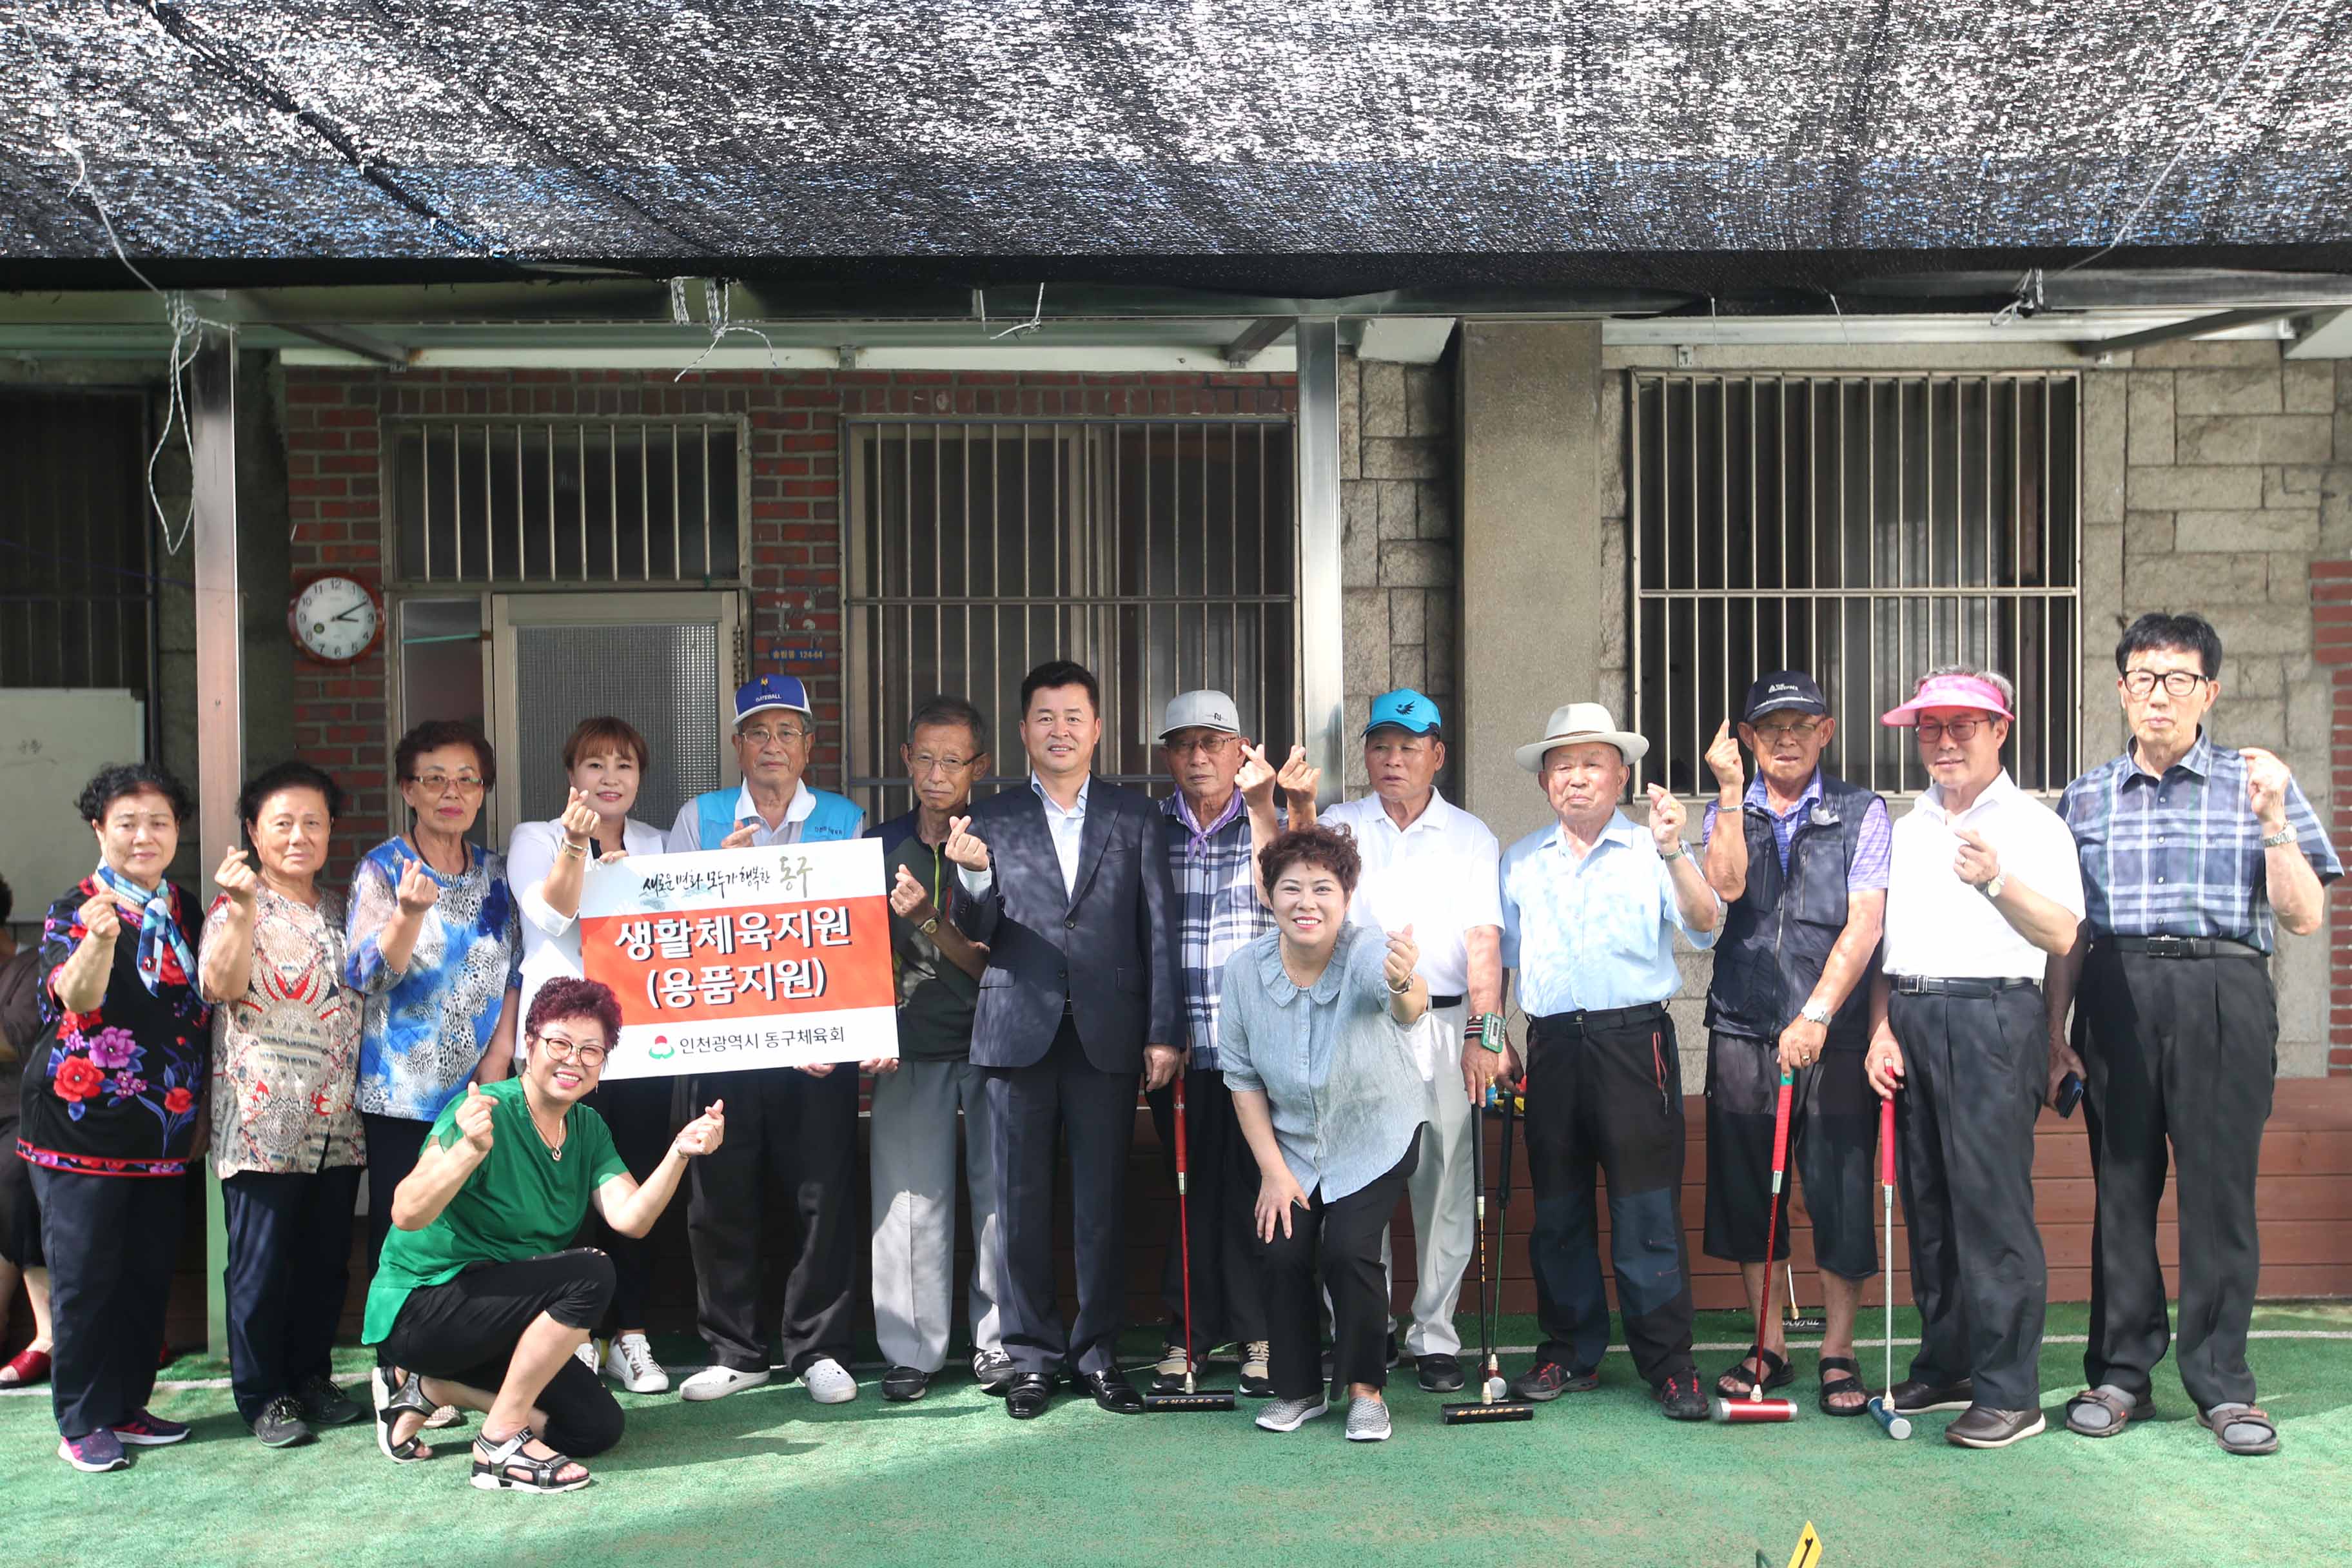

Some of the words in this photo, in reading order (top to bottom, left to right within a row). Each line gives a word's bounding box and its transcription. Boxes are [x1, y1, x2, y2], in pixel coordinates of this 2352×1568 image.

[330, 578, 342, 589] 12
[315, 585, 323, 594] 11
[352, 585, 356, 594] 1
[302, 597, 312, 607] 10
[299, 613, 307, 623] 9
[368, 613, 374, 624] 3
[306, 631, 313, 642] 8
[362, 631, 369, 640] 4
[318, 643, 325, 654] 7
[335, 646, 341, 657] 6
[351, 642, 358, 652] 5
[643, 873, 674, 897] 새로운
[676, 870, 703, 890] 변화
[707, 871, 738, 899] 모두가
[740, 866, 770, 891] 행복한
[779, 856, 813, 898] 동구
[615, 906, 852, 961] 생활체육지원
[647, 957, 827, 1009] (용품지원)
[680, 1031, 759, 1055] 인천광역시
[765, 1026, 845, 1048] 동구체육회
